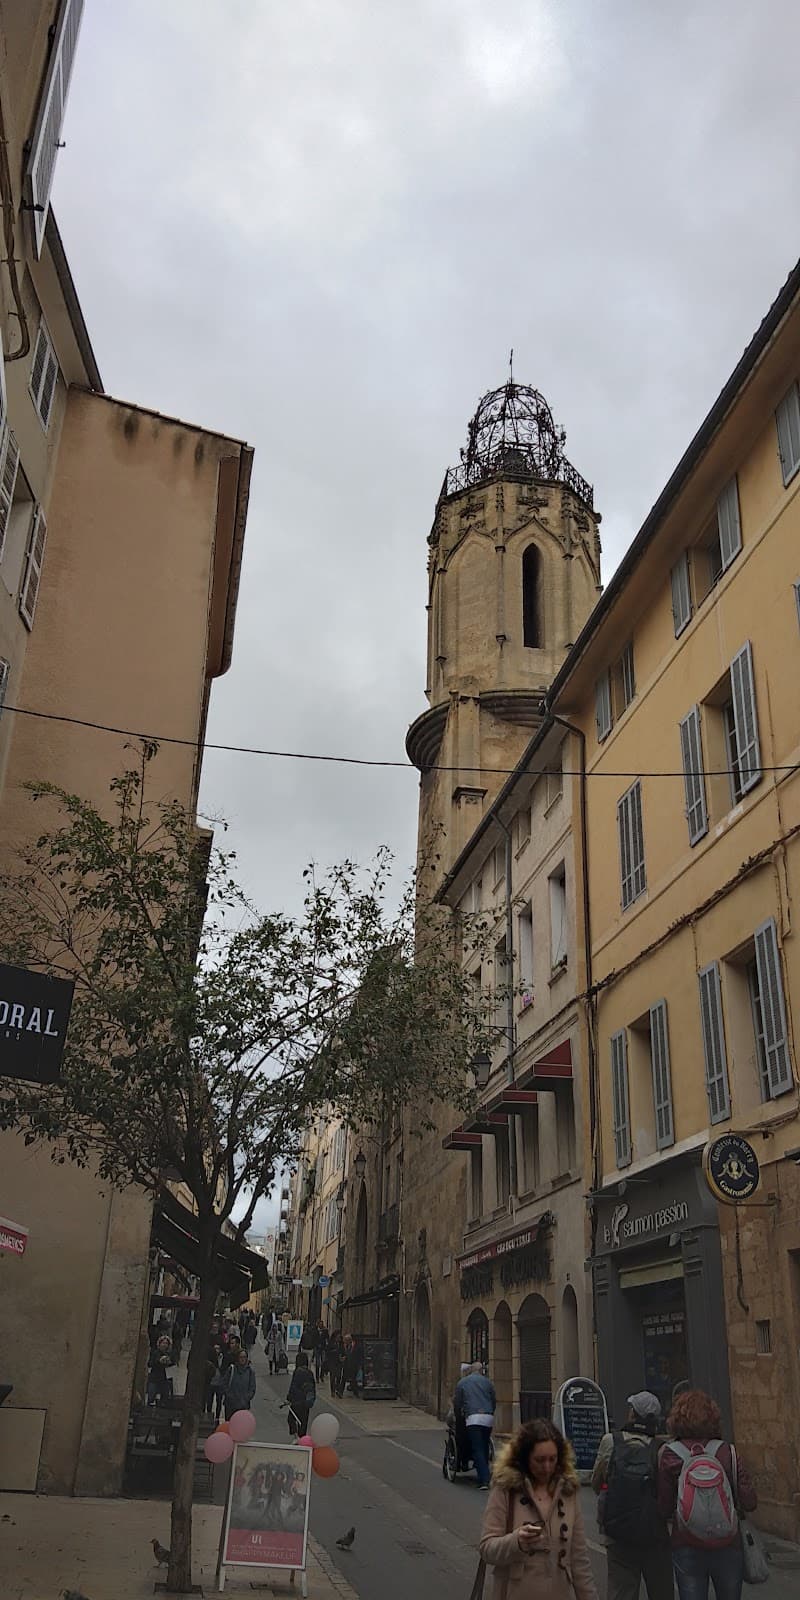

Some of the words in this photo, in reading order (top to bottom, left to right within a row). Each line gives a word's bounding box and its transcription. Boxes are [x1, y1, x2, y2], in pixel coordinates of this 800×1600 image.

[603, 1224, 611, 1243] le
[623, 1214, 654, 1238] saumon
[654, 1199, 689, 1233] passion
